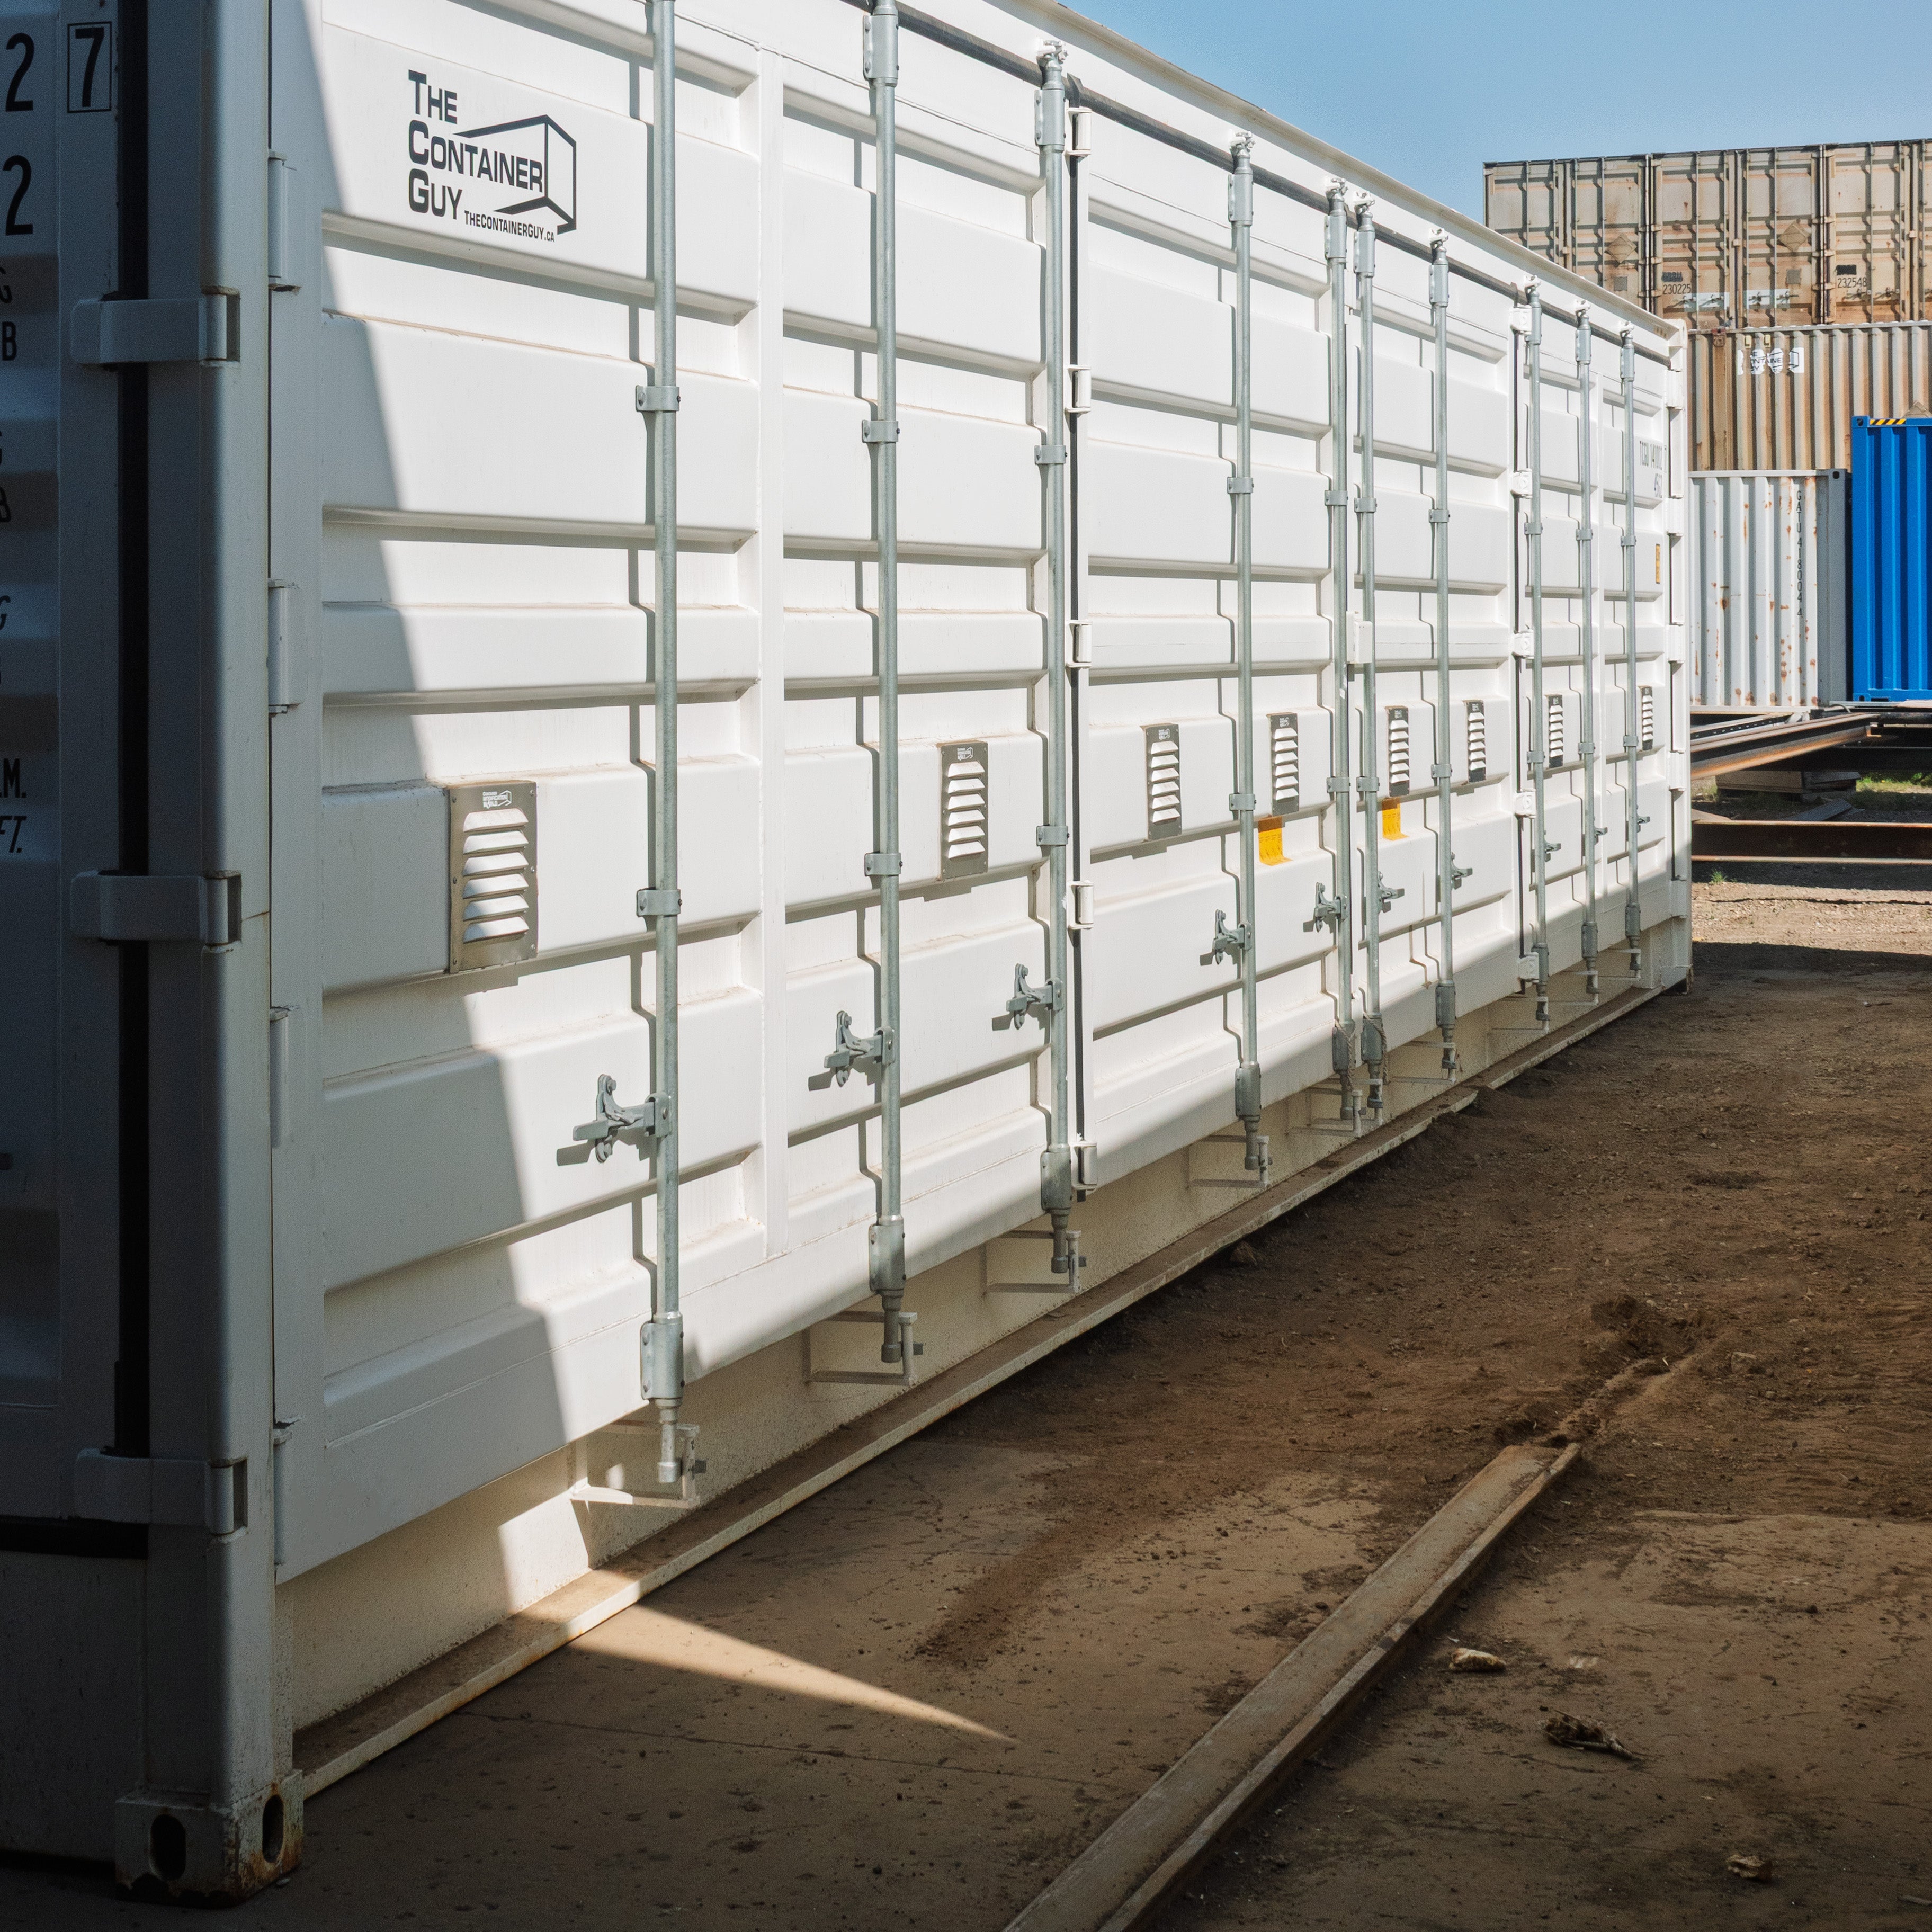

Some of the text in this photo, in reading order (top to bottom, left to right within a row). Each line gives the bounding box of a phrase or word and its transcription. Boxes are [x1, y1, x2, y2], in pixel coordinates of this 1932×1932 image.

[75, 27, 105, 108] 7
[408, 69, 458, 125] THE
[408, 120, 543, 193] CONTAINER
[408, 168, 463, 220] GUY
[1663, 284, 1692, 295] 230225
[1837, 277, 1867, 289] 232548
